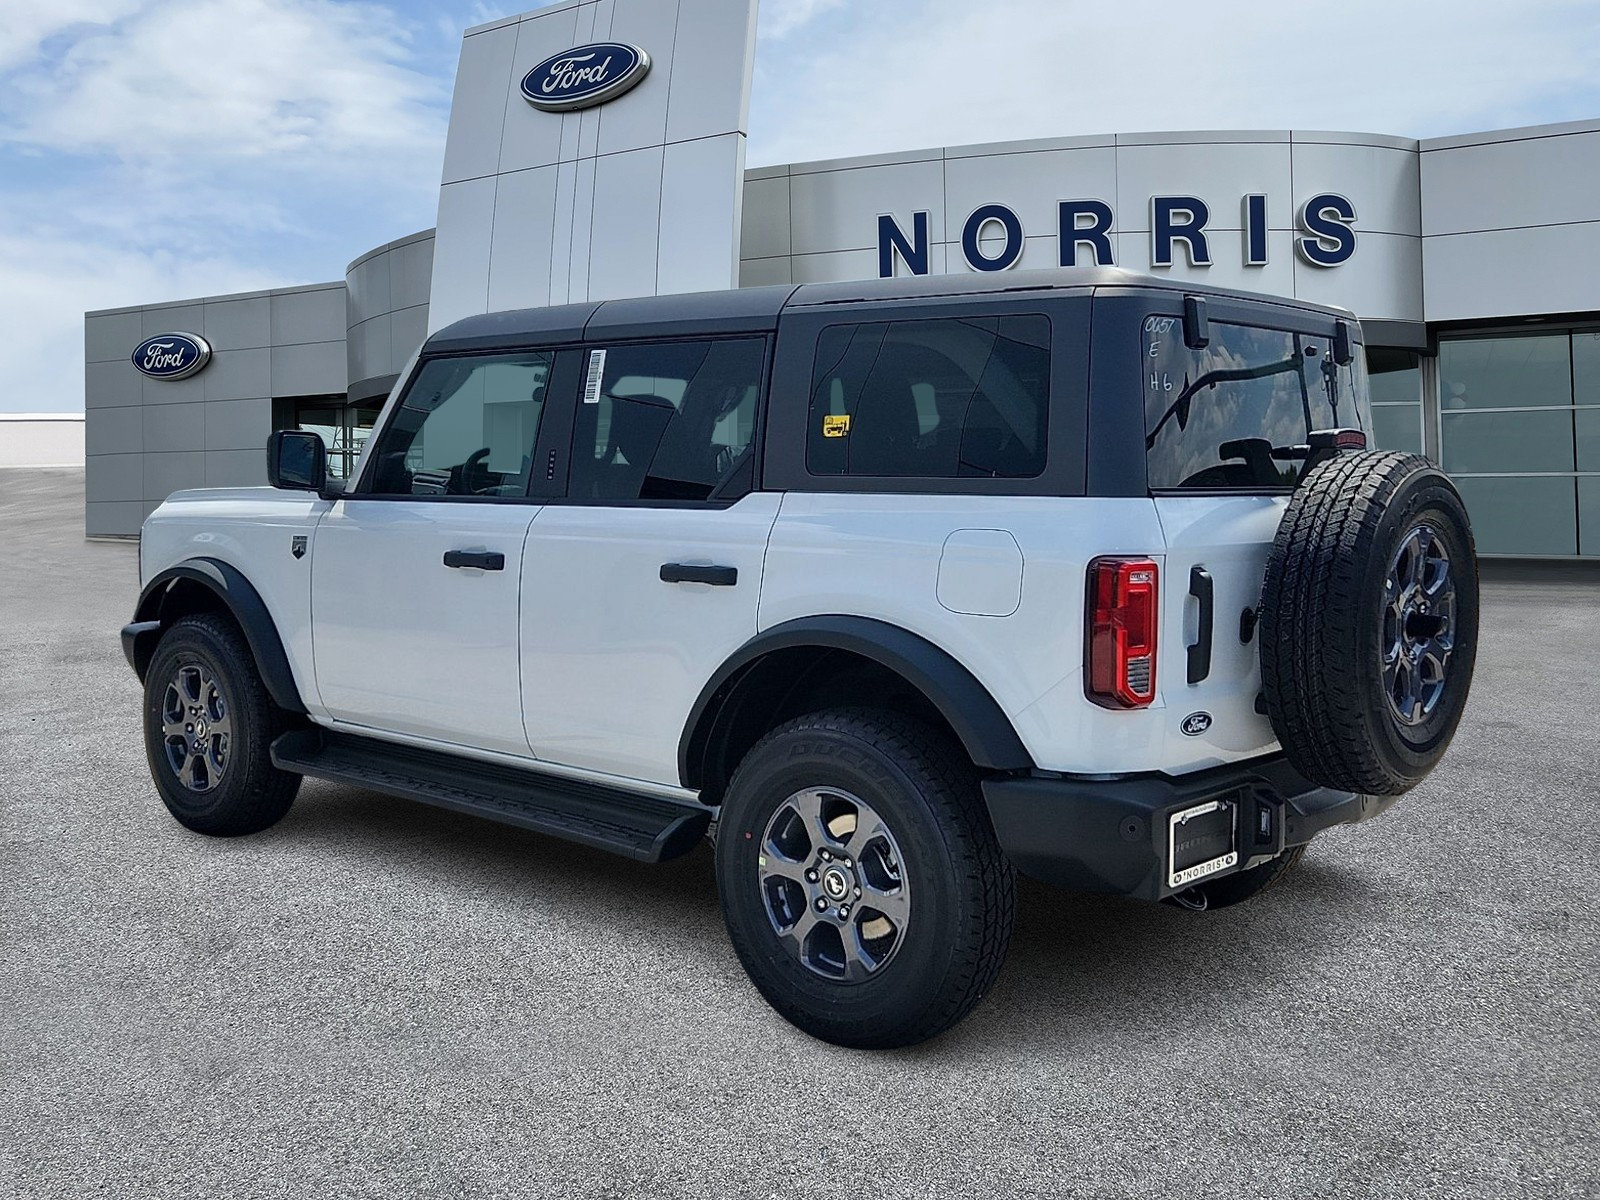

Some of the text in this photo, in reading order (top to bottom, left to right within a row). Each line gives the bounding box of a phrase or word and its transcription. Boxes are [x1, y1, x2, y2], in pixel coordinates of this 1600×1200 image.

[542, 53, 612, 93] Ford
[876, 192, 1358, 279] NORRIS
[144, 343, 185, 370] Ford
[1149, 341, 1161, 357] E
[1187, 716, 1208, 732] Ford
